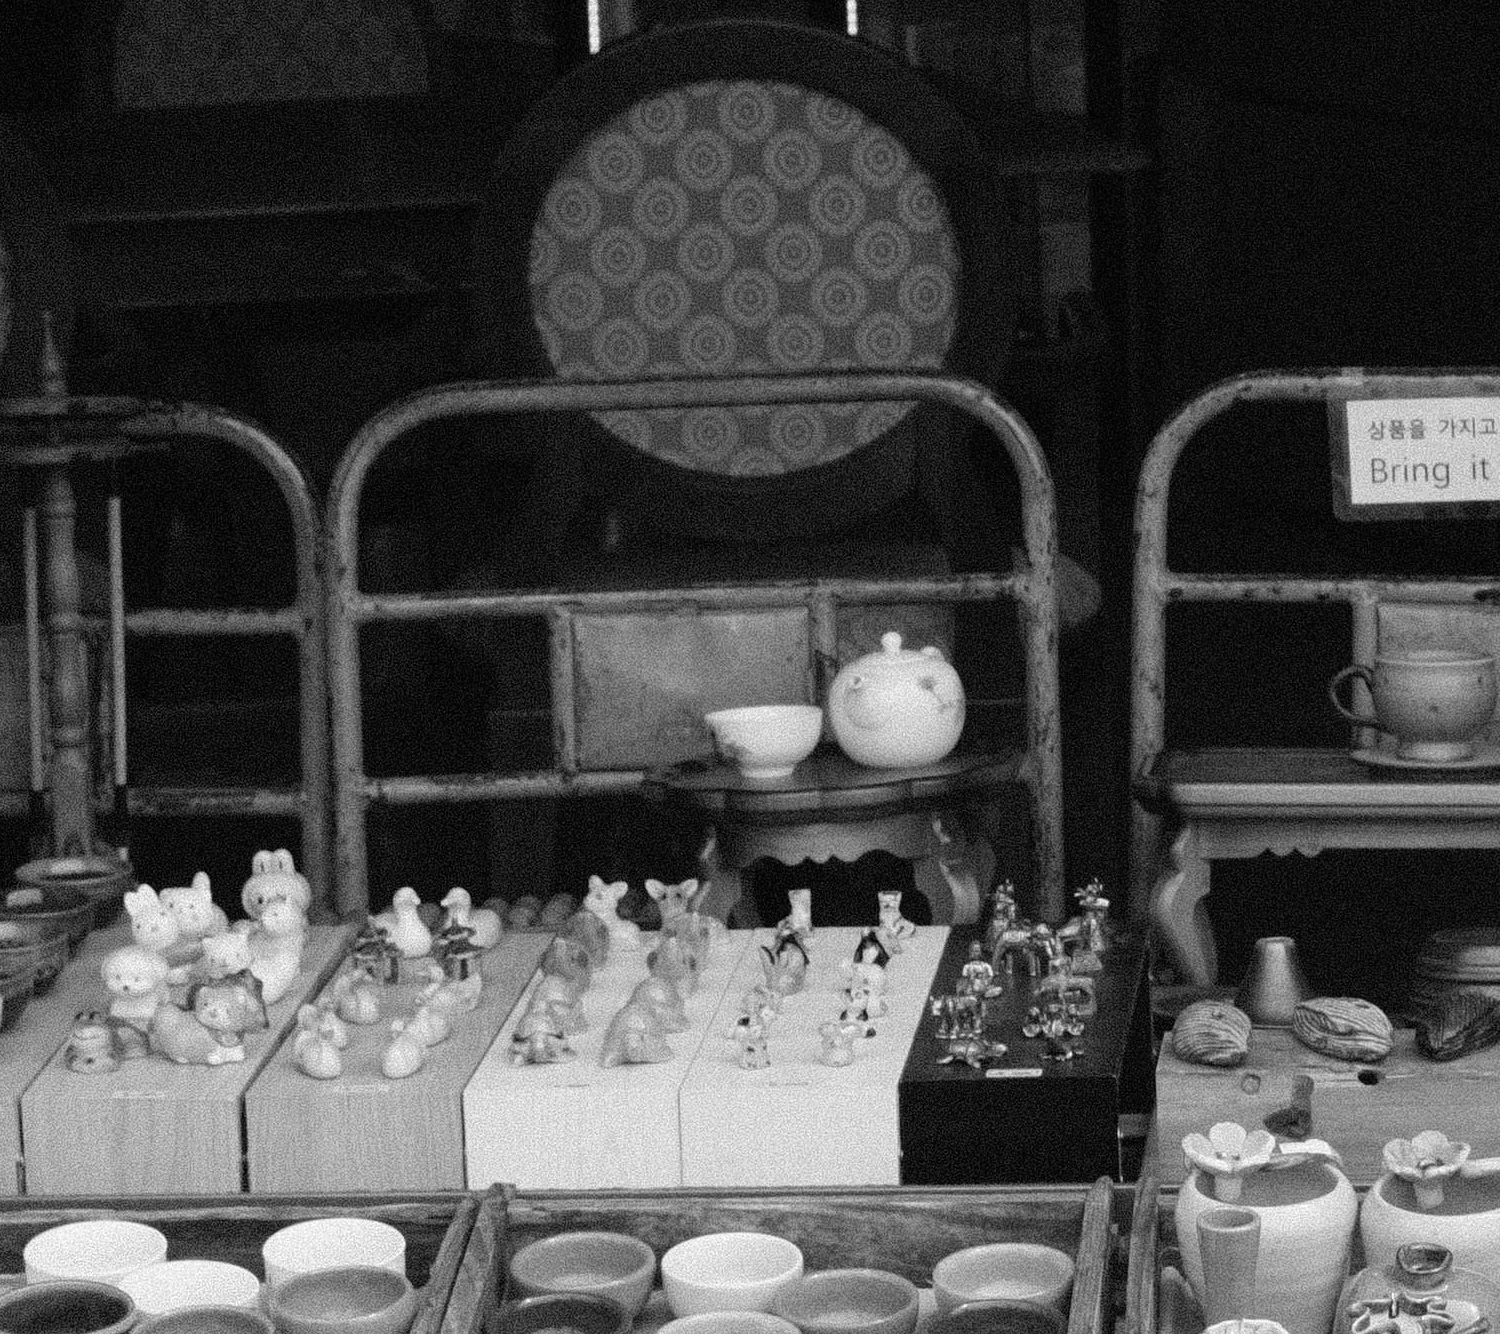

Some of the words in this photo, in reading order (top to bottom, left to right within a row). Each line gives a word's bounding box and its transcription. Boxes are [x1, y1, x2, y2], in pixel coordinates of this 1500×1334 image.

[1368, 418, 1426, 440] 상품을
[1439, 417, 1498, 438] 가지고
[1370, 457, 1451, 489] Bring
[1471, 455, 1490, 481] it
